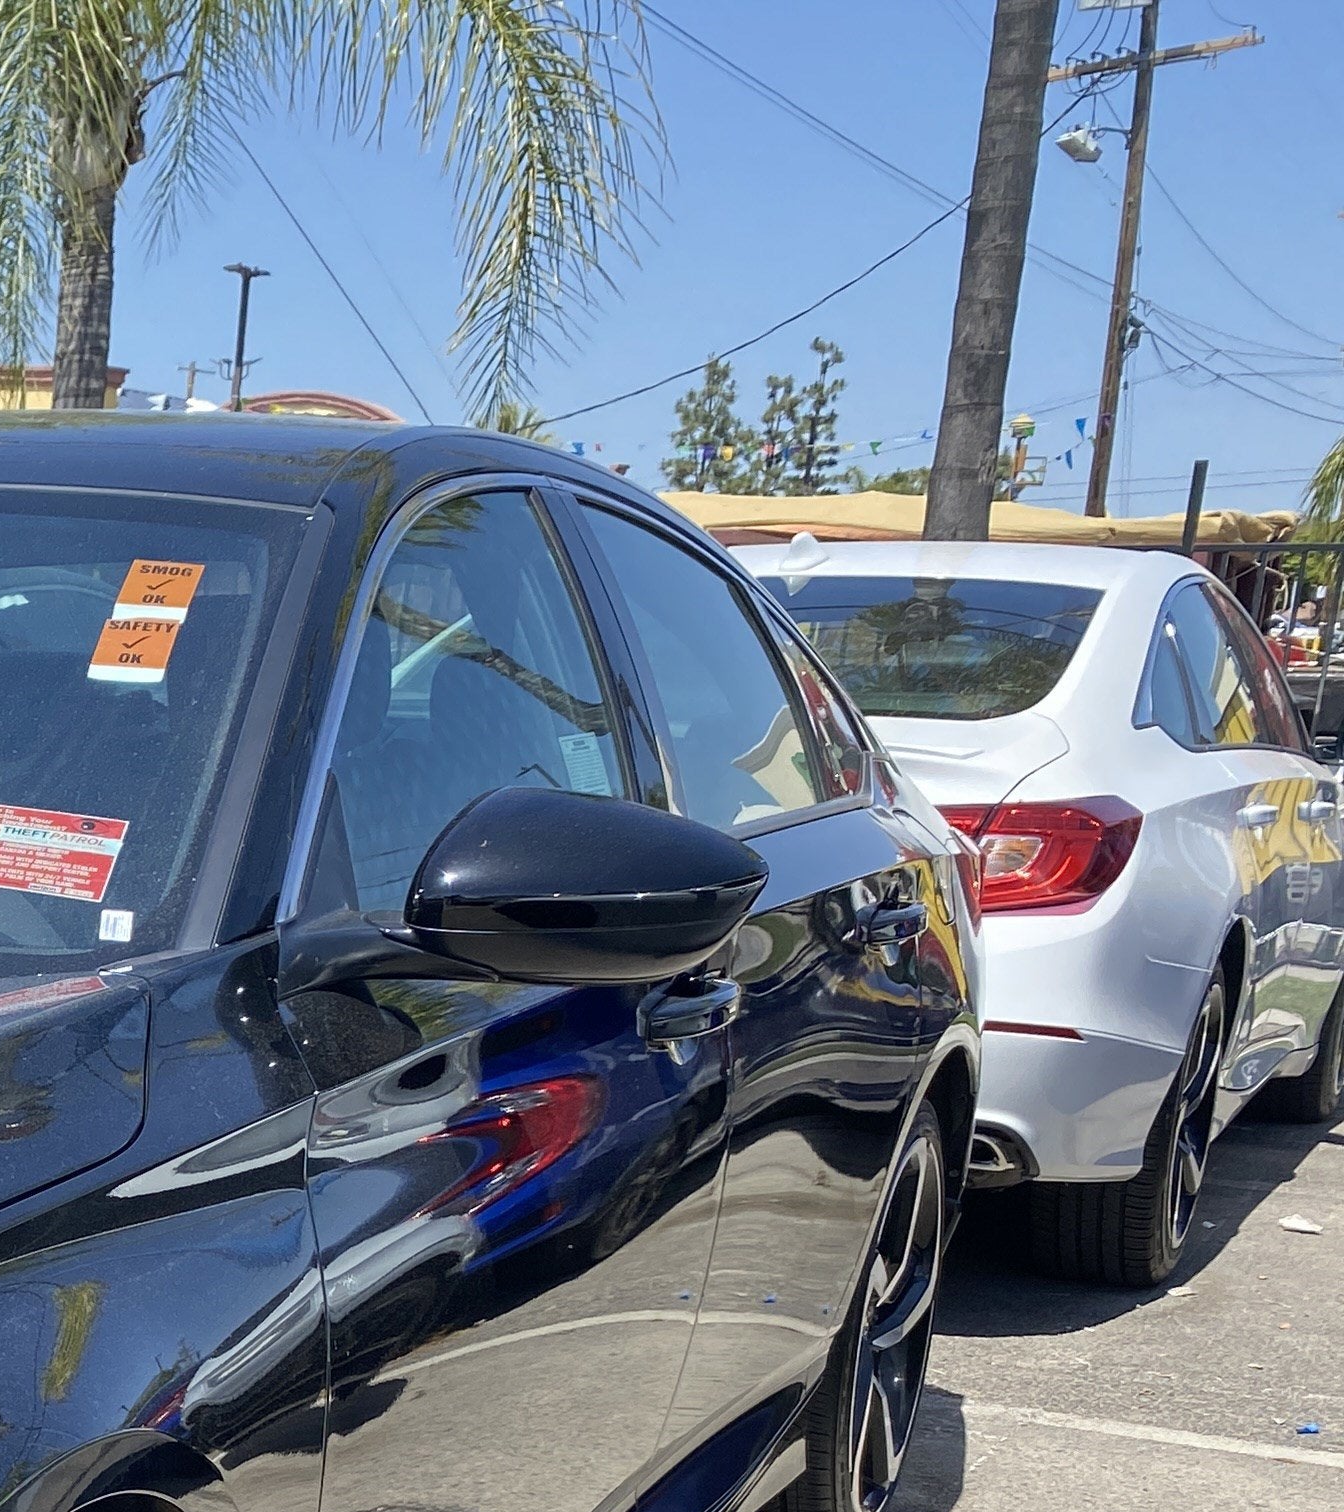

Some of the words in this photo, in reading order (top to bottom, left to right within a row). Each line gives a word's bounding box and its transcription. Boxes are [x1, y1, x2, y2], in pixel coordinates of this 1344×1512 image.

[139, 564, 193, 577] SMOG
[142, 594, 167, 604] OK
[108, 620, 176, 633] SAFETY
[118, 653, 144, 664] OK
